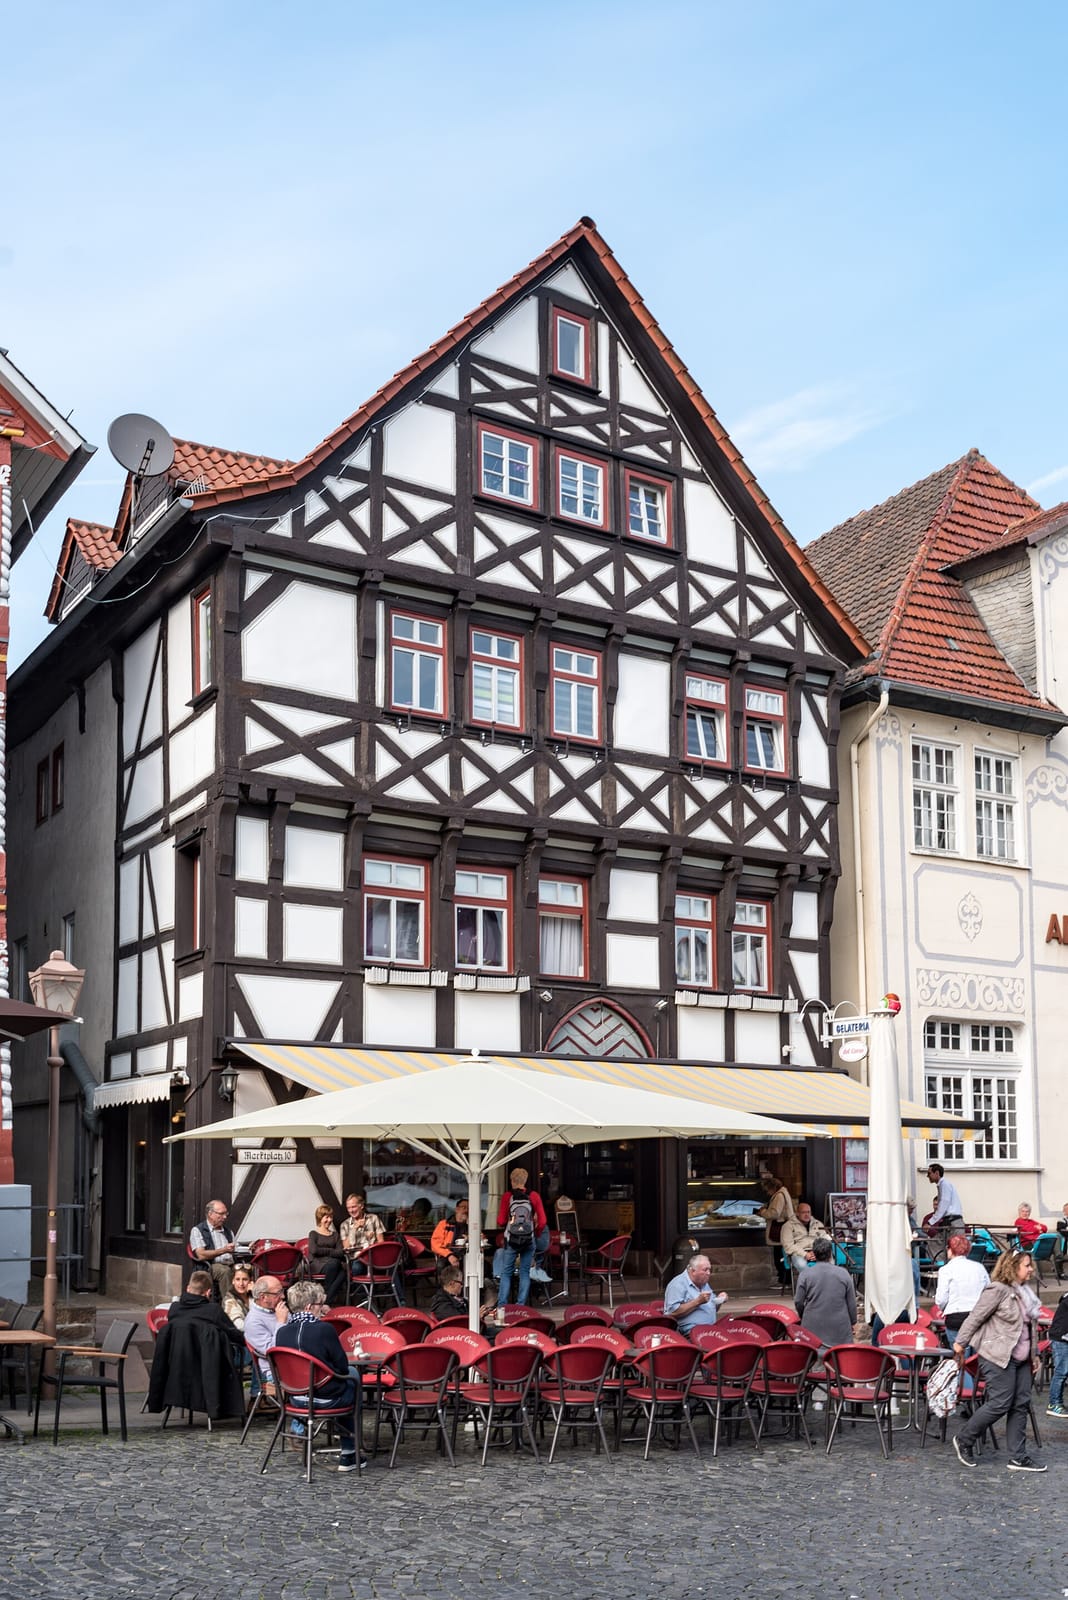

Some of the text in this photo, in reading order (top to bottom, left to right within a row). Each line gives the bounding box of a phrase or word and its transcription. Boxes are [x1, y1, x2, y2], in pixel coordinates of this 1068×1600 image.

[836, 1022, 869, 1033] GELATERIA
[244, 1151, 292, 1162] Marktplatz 10
